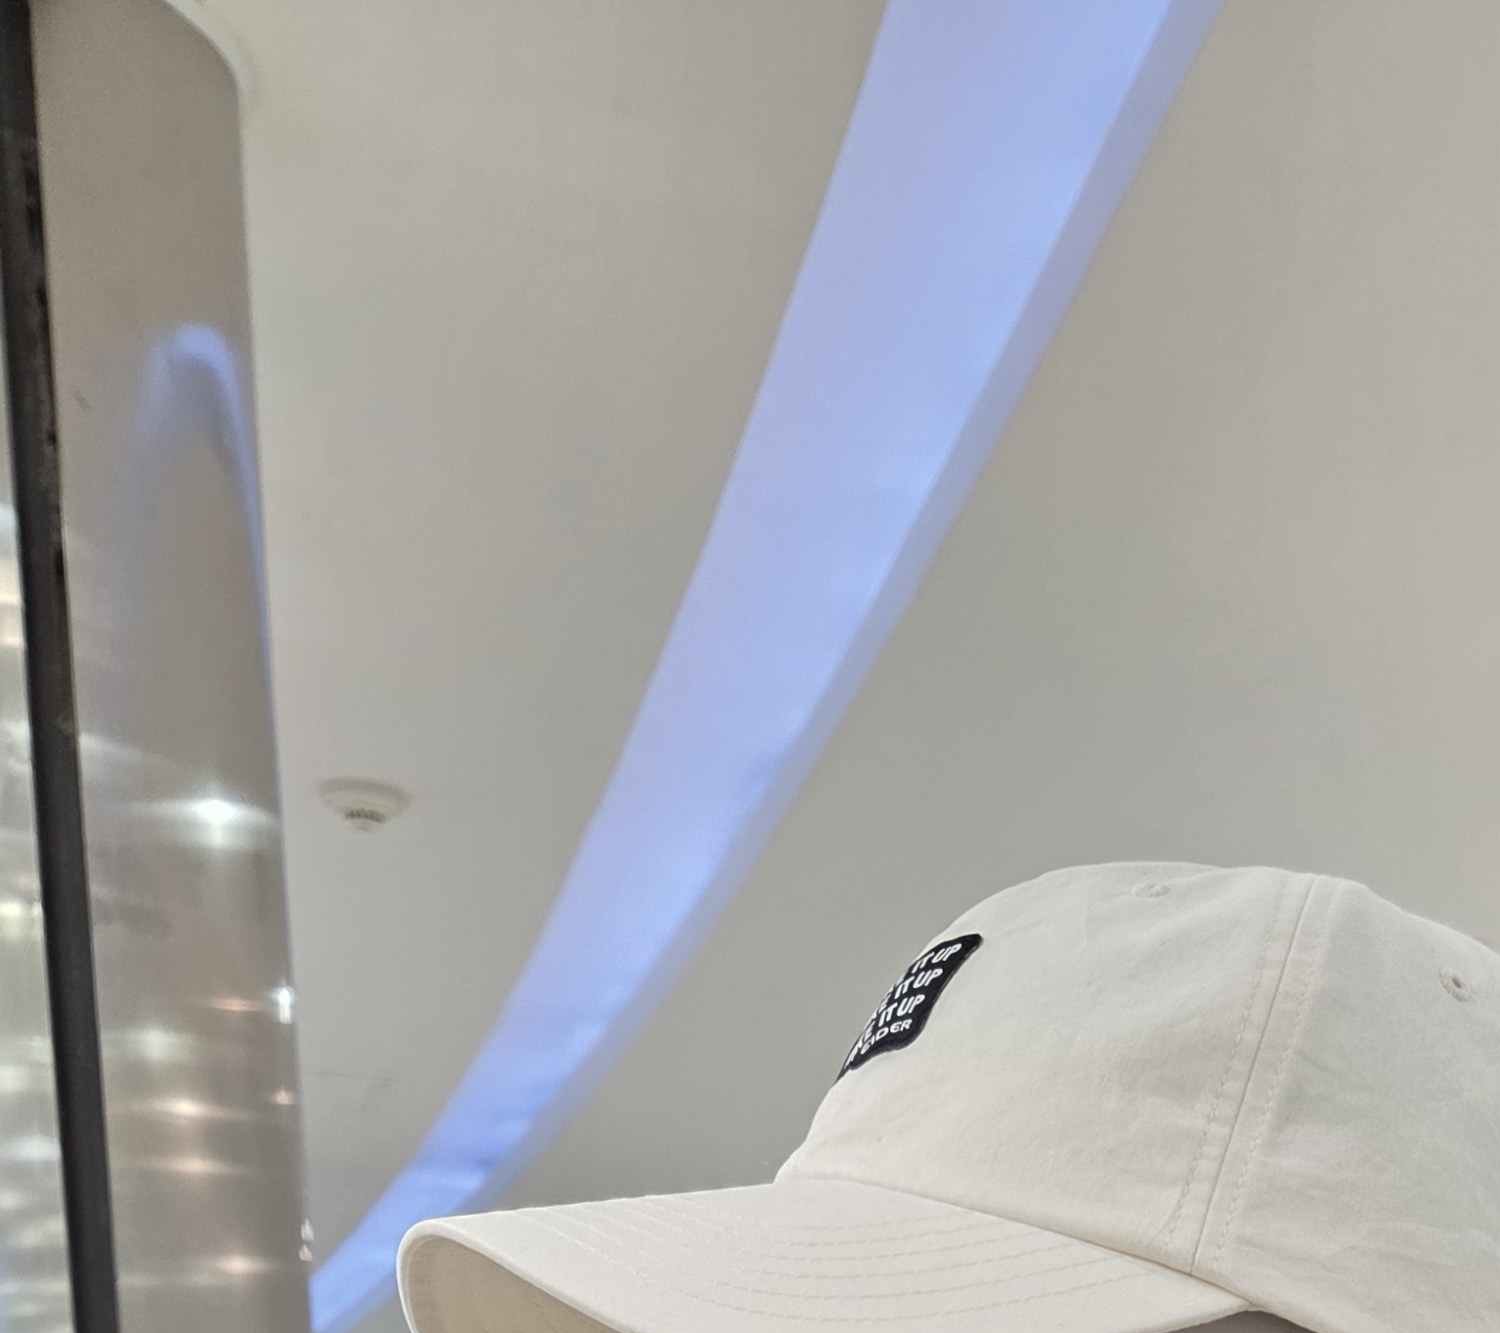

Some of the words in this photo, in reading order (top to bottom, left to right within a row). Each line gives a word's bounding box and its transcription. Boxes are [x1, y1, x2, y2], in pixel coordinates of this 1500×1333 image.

[911, 951, 936, 974] IT
[931, 943, 962, 964] UP
[894, 975, 916, 1000] IT
[912, 968, 944, 989] UP
[878, 1002, 898, 1027] IT
[896, 994, 926, 1017] UP
[860, 1019, 913, 1055] EIDER
